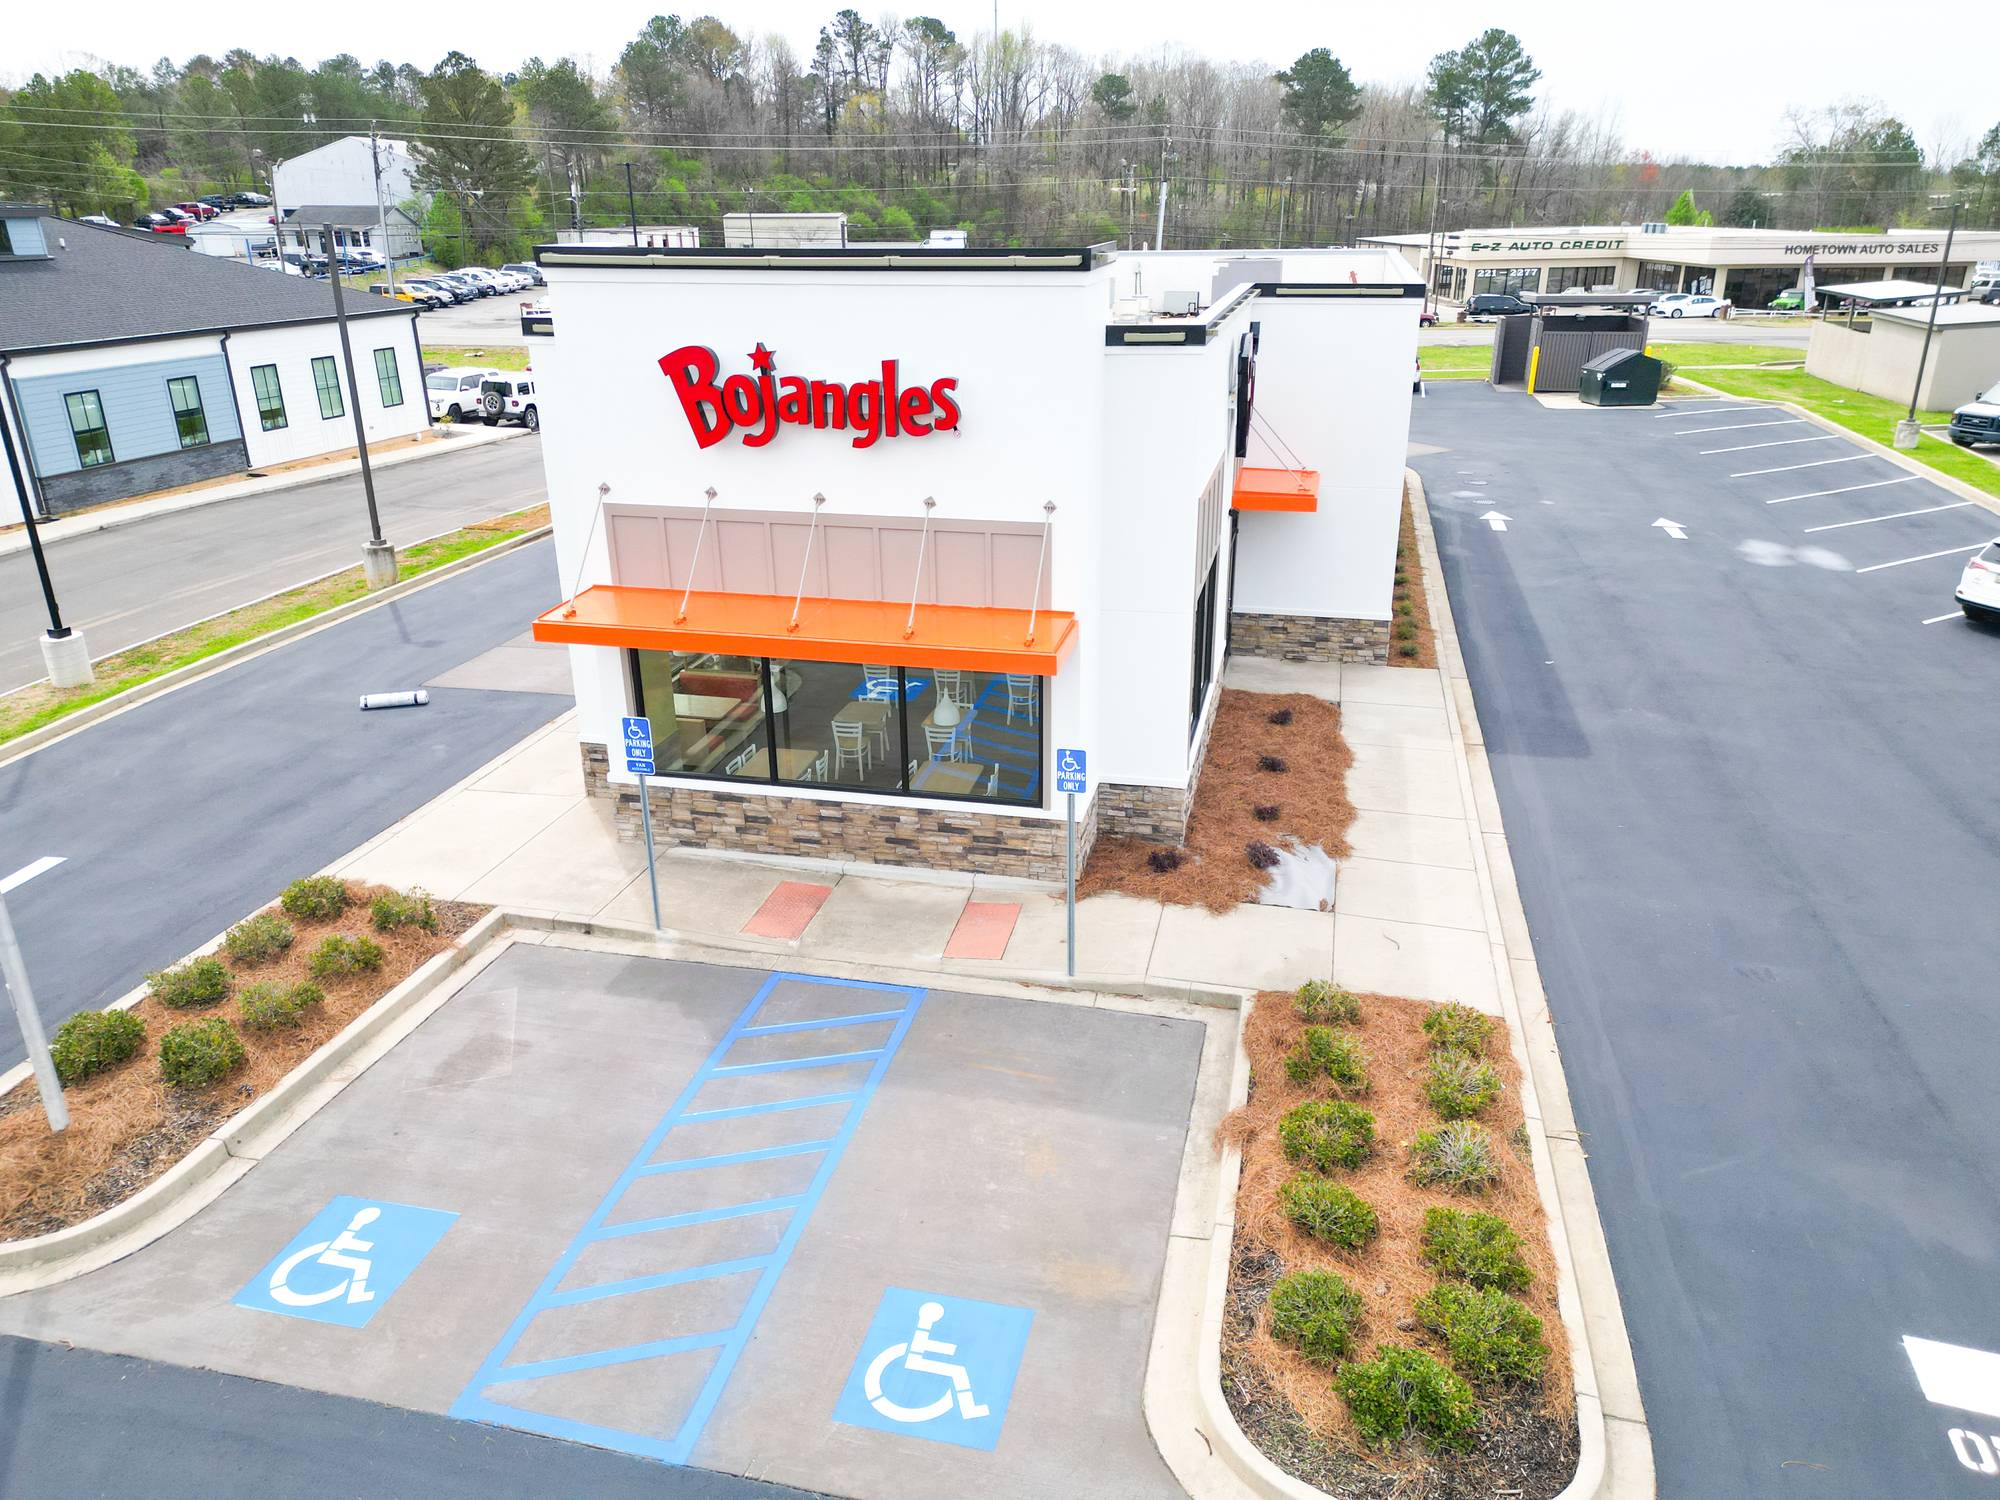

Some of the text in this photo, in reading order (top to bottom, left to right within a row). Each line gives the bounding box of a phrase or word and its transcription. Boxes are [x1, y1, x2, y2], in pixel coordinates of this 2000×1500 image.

[1508, 241, 1553, 251] AUTO
[1560, 240, 1624, 250] CREDIT
[1784, 243, 1939, 255] HOMETOWN AUTO SALES
[657, 342, 962, 450] Bojangles
[625, 738, 650, 748] PARKING
[631, 749, 646, 757] ONLY
[1057, 771, 1085, 781] PARKING
[1063, 781, 1079, 790] ONLY
